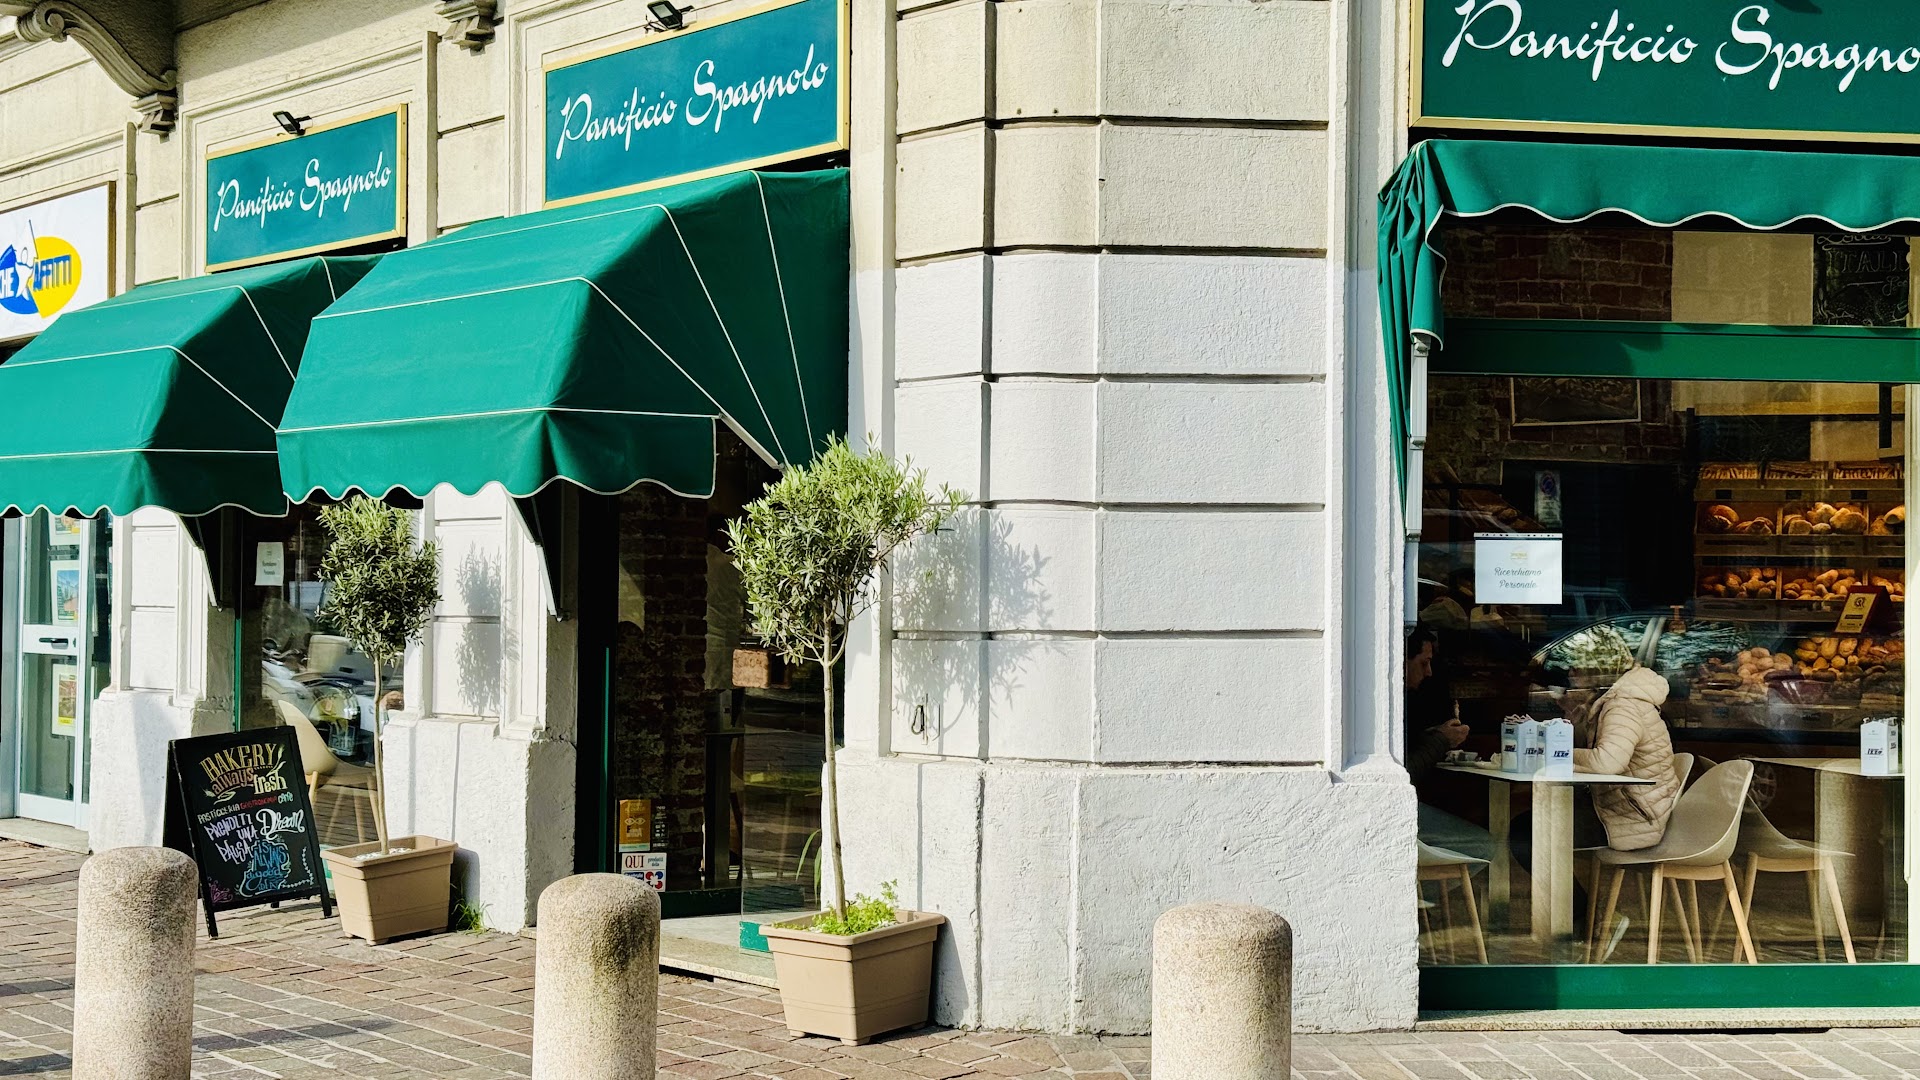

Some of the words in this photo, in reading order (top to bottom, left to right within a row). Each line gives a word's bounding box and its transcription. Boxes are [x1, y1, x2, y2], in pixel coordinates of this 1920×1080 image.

[1442, 0, 1699, 82] Panificio
[555, 87, 678, 161] Panificio
[685, 43, 829, 134] Spagnolo
[213, 176, 295, 233] Panificio
[300, 151, 392, 219] Spagnolo
[199, 743, 277, 783] BAKERY
[211, 767, 255, 795] always
[253, 768, 288, 795] fresh
[625, 855, 645, 868] QUI
